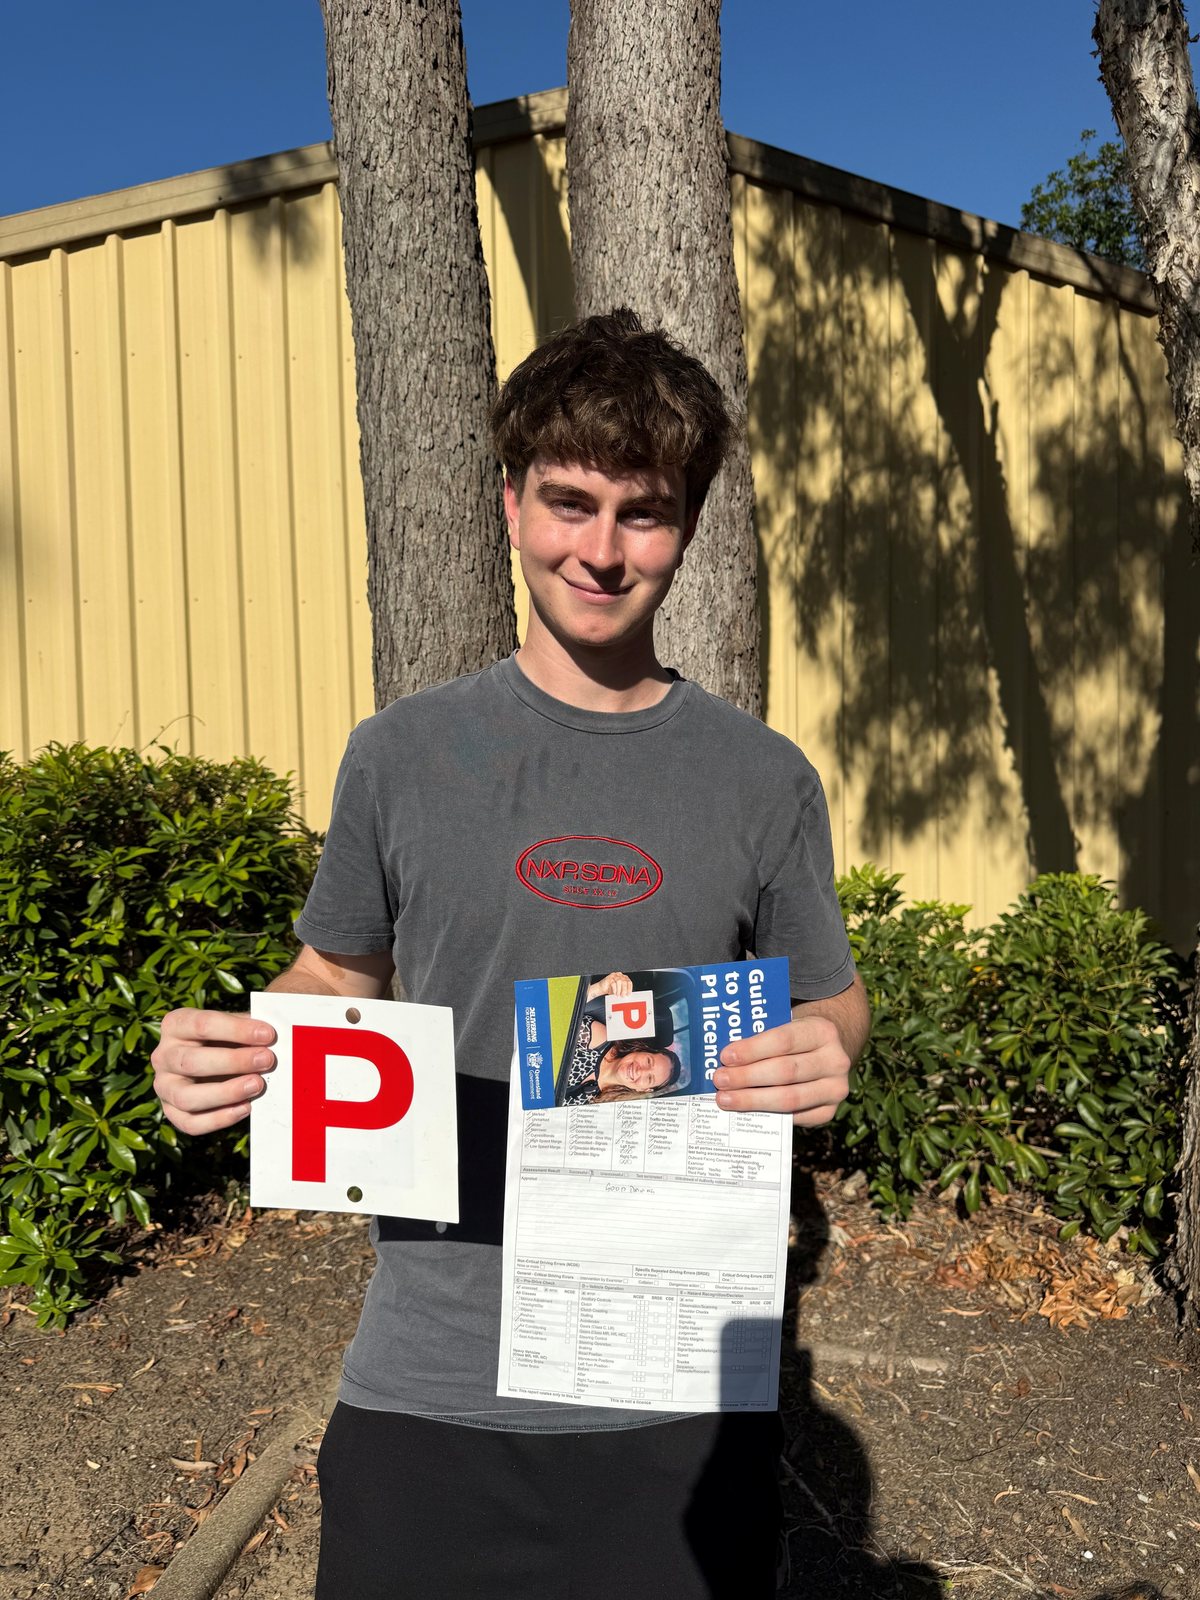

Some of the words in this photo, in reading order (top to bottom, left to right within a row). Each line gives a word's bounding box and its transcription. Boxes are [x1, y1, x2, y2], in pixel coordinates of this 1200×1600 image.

[700, 974, 718, 999] P1
[724, 971, 740, 995] to
[748, 969, 768, 1033] Guide
[611, 1001, 647, 1029] P
[722, 1000, 742, 1041] you
[702, 1005, 720, 1080] licence
[292, 1025, 414, 1183] P
